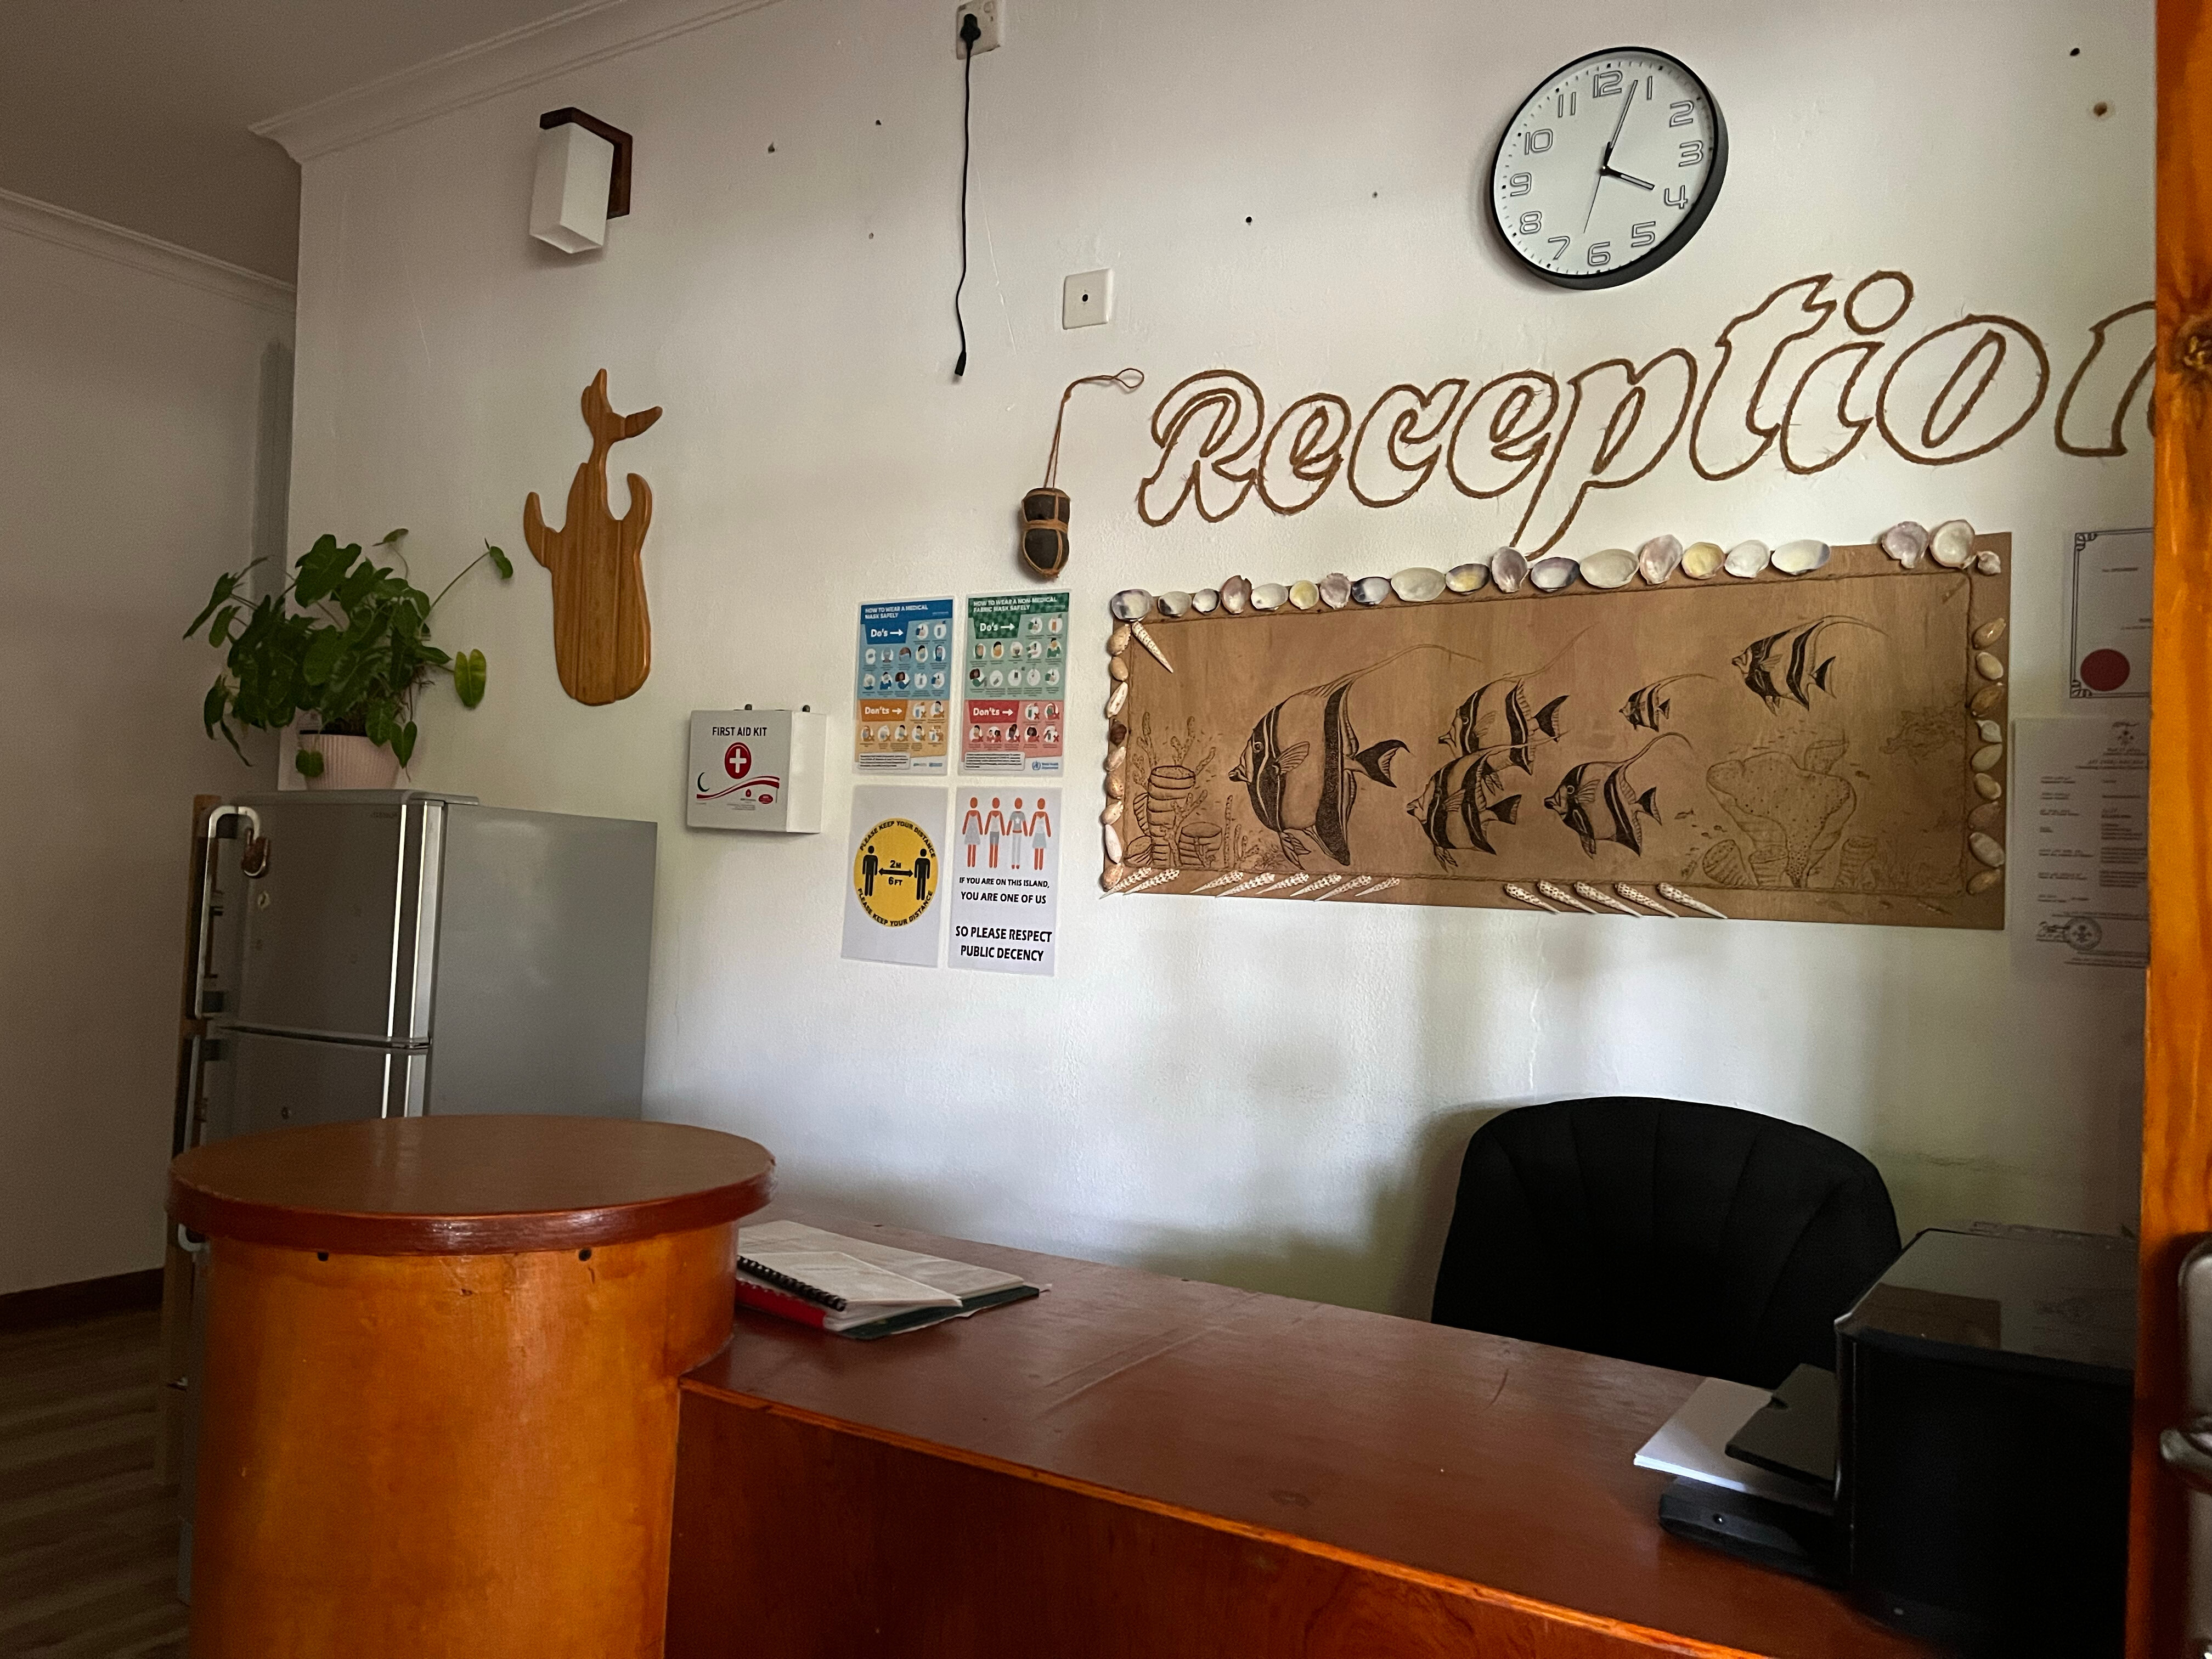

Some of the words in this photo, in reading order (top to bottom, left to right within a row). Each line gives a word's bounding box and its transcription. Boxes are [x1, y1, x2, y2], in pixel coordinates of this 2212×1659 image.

[1593, 70, 1623, 98] 12
[1646, 76, 1652, 100] 1
[1559, 92, 1576, 117] 11
[1669, 100, 1694, 127] 2
[1525, 128, 1553, 155] 10
[1679, 140, 1704, 167] 3
[1510, 172, 1532, 197] 9
[1664, 185, 1688, 209] 4
[1520, 211, 1542, 234] 8
[1631, 221, 1656, 248] 5
[1548, 236, 1571, 260] 7
[1587, 241, 1611, 266] 6
[871, 629, 888, 637] Do's
[980, 622, 998, 631] Do's
[973, 707, 1000, 716] Don'ts
[712, 727, 735, 736] FIRST
[737, 727, 751, 736] AID
[753, 727, 767, 736] KIT
[860, 828, 878, 851] PLEASE
[878, 821, 894, 830] KEEP
[896, 821, 913, 830] YOUR
[913, 827, 936, 858] DISTANCE
[1023, 880, 1049, 888] ISLAND,
[857, 888, 872, 915] PLEASE
[873, 913, 888, 925] KEEP
[909, 890, 933, 922] DISTANCE
[961, 891, 979, 900] YOU
[980, 893, 998, 901] ARE
[1000, 894, 1019, 902] ONE
[1021, 894, 1033, 903] OF
[1036, 895, 1046, 904] US
[956, 926, 968, 936] SO
[970, 927, 1006, 939] PLEASE
[1009, 929, 1052, 942] RESPECT
[961, 945, 995, 958] PUBLIC
[997, 947, 1043, 961] DECENCY
